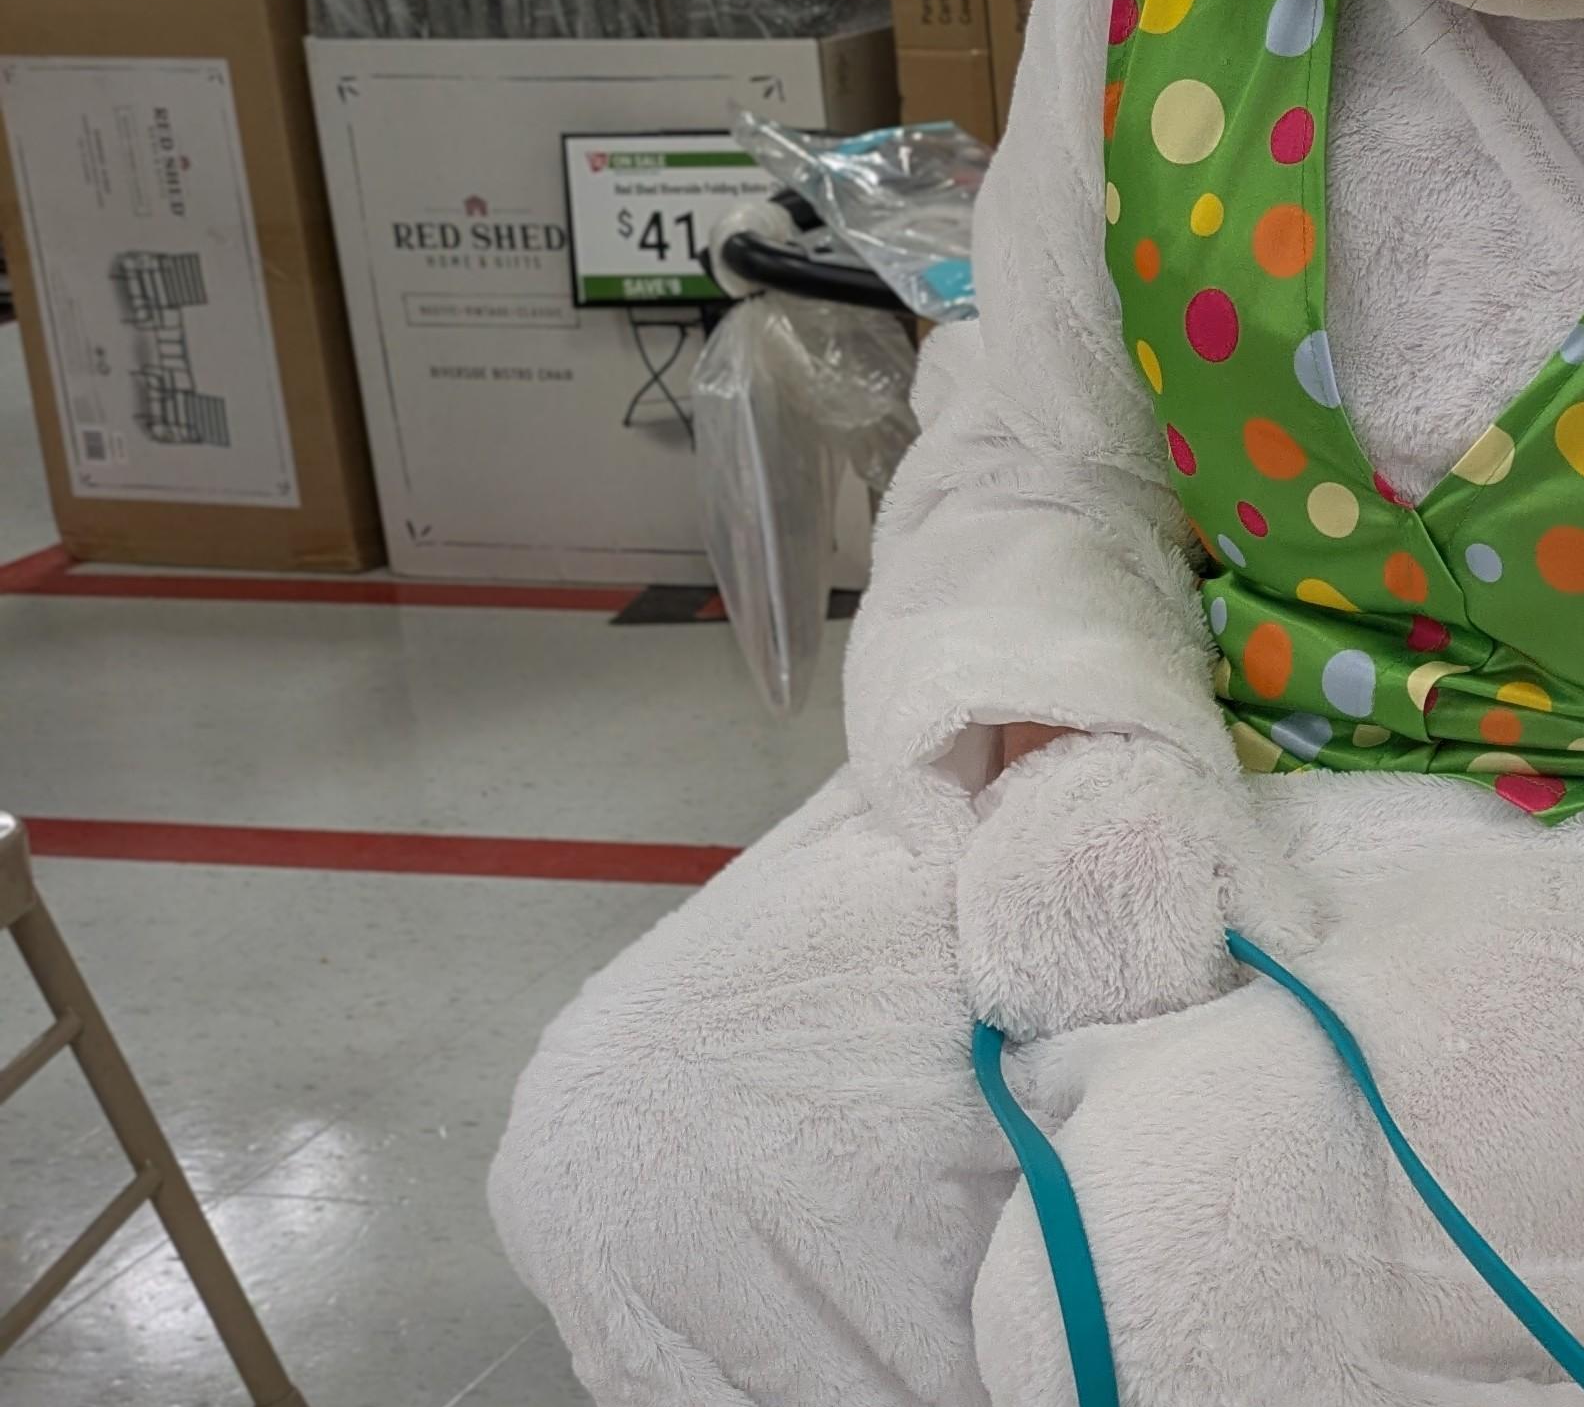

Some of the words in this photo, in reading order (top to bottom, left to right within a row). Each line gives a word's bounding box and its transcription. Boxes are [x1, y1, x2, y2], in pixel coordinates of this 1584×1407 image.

[392, 222, 461, 250] RED
[469, 222, 566, 252] SHED
[426, 255, 471, 268] HOME
[493, 256, 542, 270] GIFTS
[538, 368, 574, 384] CHAIR
